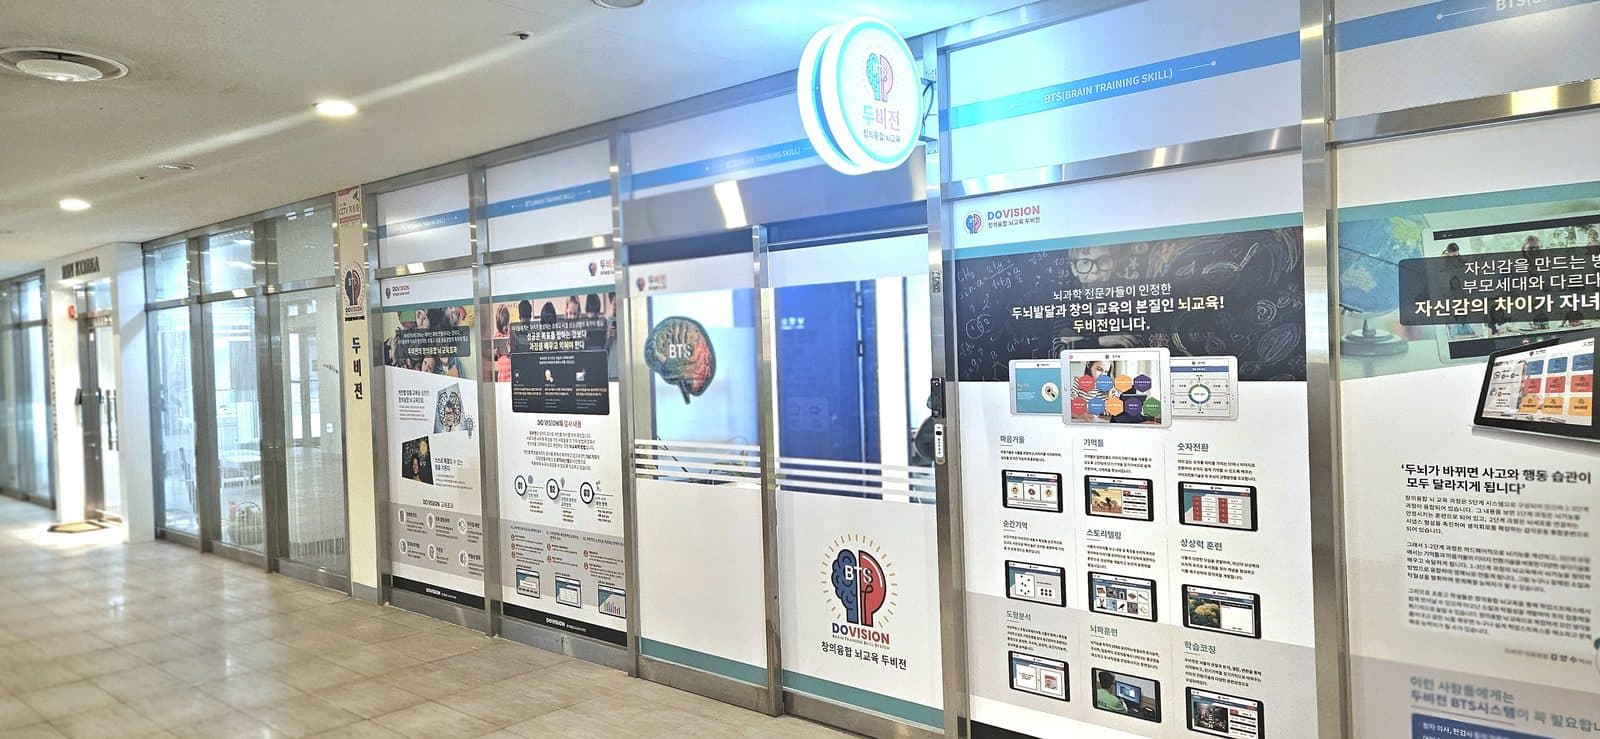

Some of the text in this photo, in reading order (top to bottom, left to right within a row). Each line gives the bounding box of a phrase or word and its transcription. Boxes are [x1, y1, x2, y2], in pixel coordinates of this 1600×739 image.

[1044, 68, 1173, 104] BTS(BRAIN TRAINING SKILL)
[862, 105, 900, 131] 두비전
[987, 205, 1040, 220] DOVISION
[1465, 258, 1530, 276] 자신감을
[1535, 254, 1586, 272] 만드는
[1053, 282, 1171, 301] 뇌과학 전문가들이 인정한
[1463, 275, 1545, 294] 부모세대와
[1012, 296, 1224, 320] 두뇌발달과 창의 교육의 본질인 뇌교육!
[1415, 298, 1488, 317] 자신감의
[1494, 294, 1554, 314] 차이가
[1073, 317, 1150, 334] 두비전입니다.
[669, 344, 692, 358] BTS
[352, 337, 364, 400] 두비전
[1000, 435, 1024, 444] 마음거울
[1084, 439, 1104, 447] 기억틀
[1177, 442, 1209, 453] 숫자전환
[1443, 466, 1479, 478] 바뀌면
[1482, 467, 1520, 480] 사고와
[1522, 469, 1549, 482] 행동
[1552, 470, 1591, 484] 습관이
[1407, 478, 1430, 489] 모두
[1433, 479, 1480, 492] 달라지게
[1003, 520, 1028, 529] 순간기억
[1086, 529, 1122, 540] 스토리텔링
[1180, 538, 1222, 552] 상상력 훈련
[845, 565, 873, 584] BTS
[1006, 610, 1031, 621] 도형분석
[832, 622, 890, 645] DOVISION
[1090, 625, 1118, 637] 뇌파훈련
[822, 641, 906, 670] 창의융합 뇌교육 두비전
[1184, 641, 1216, 654] 학습코칭
[1410, 676, 1515, 704] 이런 사람들에게는
[1412, 690, 1447, 707] 두비전
[1451, 698, 1529, 722] BTS시스템이
[1535, 711, 1546, 724] 꼭
